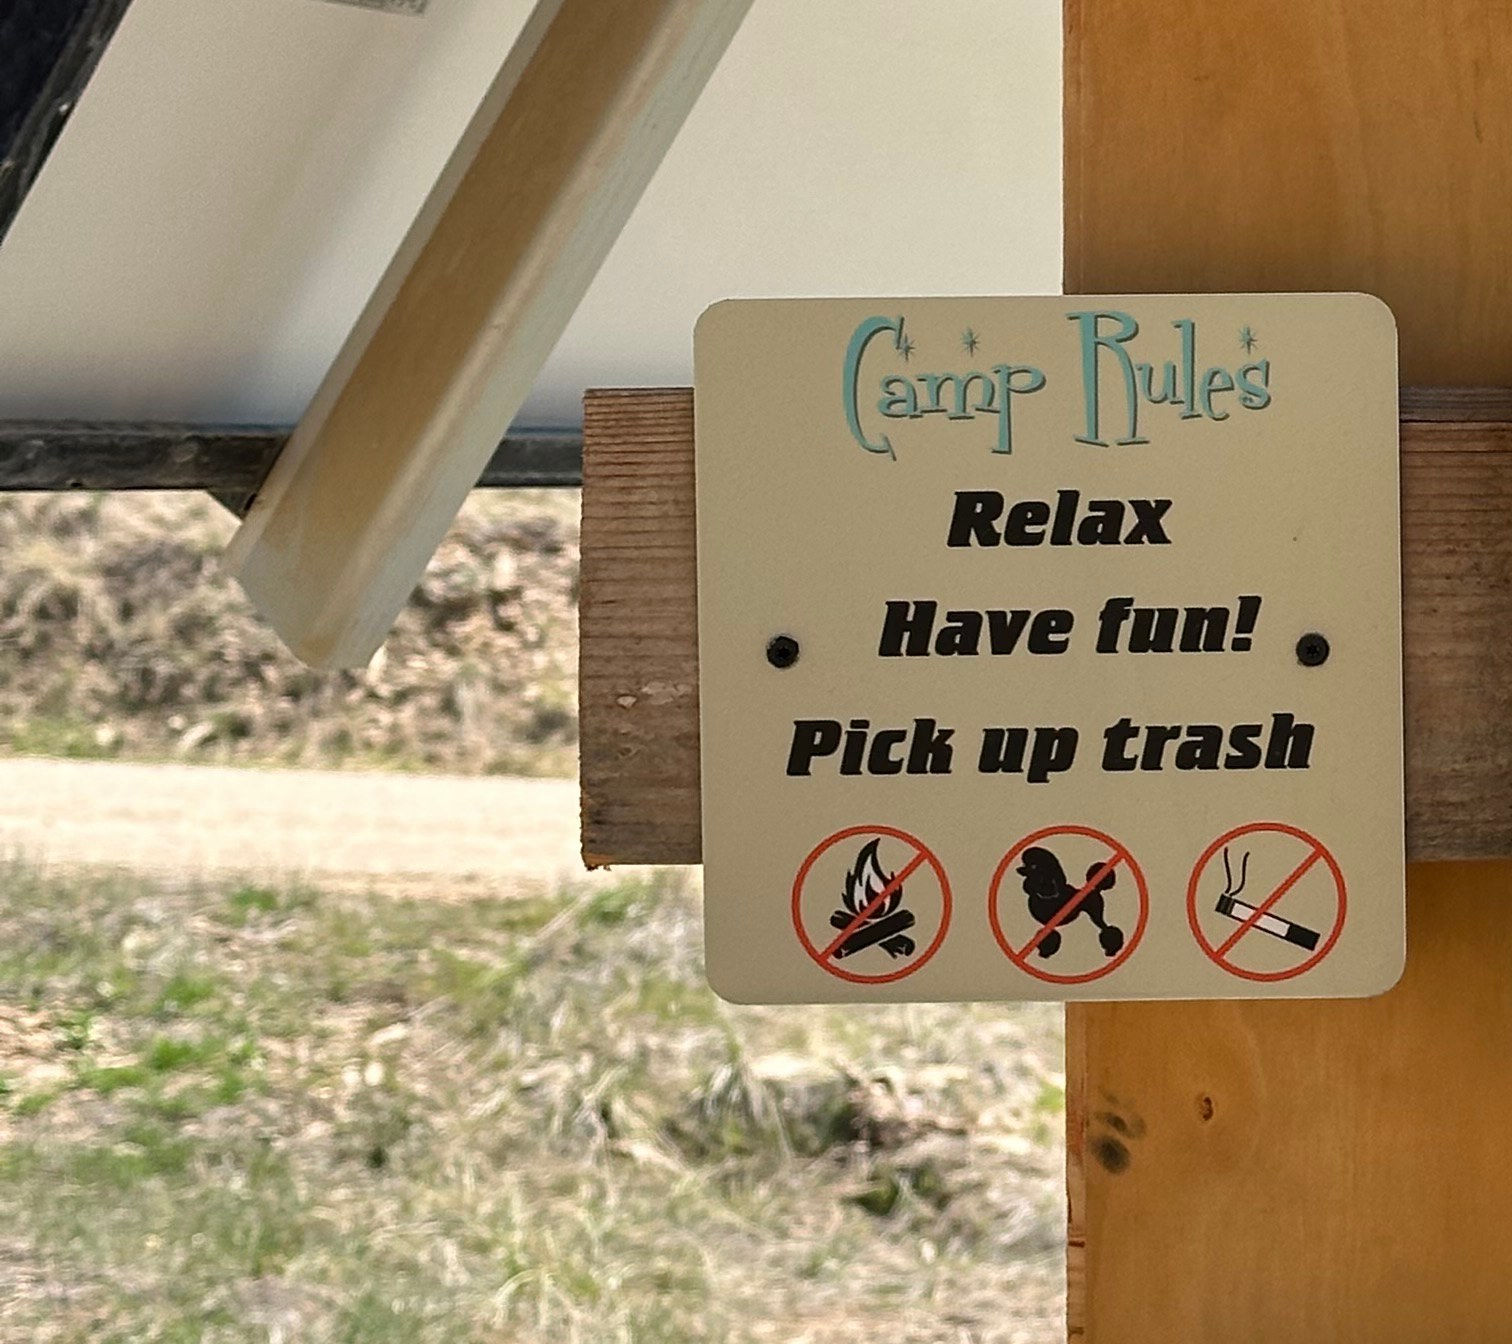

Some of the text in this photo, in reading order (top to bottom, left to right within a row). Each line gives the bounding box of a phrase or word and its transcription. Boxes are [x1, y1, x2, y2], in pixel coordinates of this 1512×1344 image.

[842, 310, 1273, 461] Camp Rules
[947, 490, 1172, 547] Relax
[879, 596, 1262, 657] Have fun!
[786, 713, 1314, 783] Pick up trash
